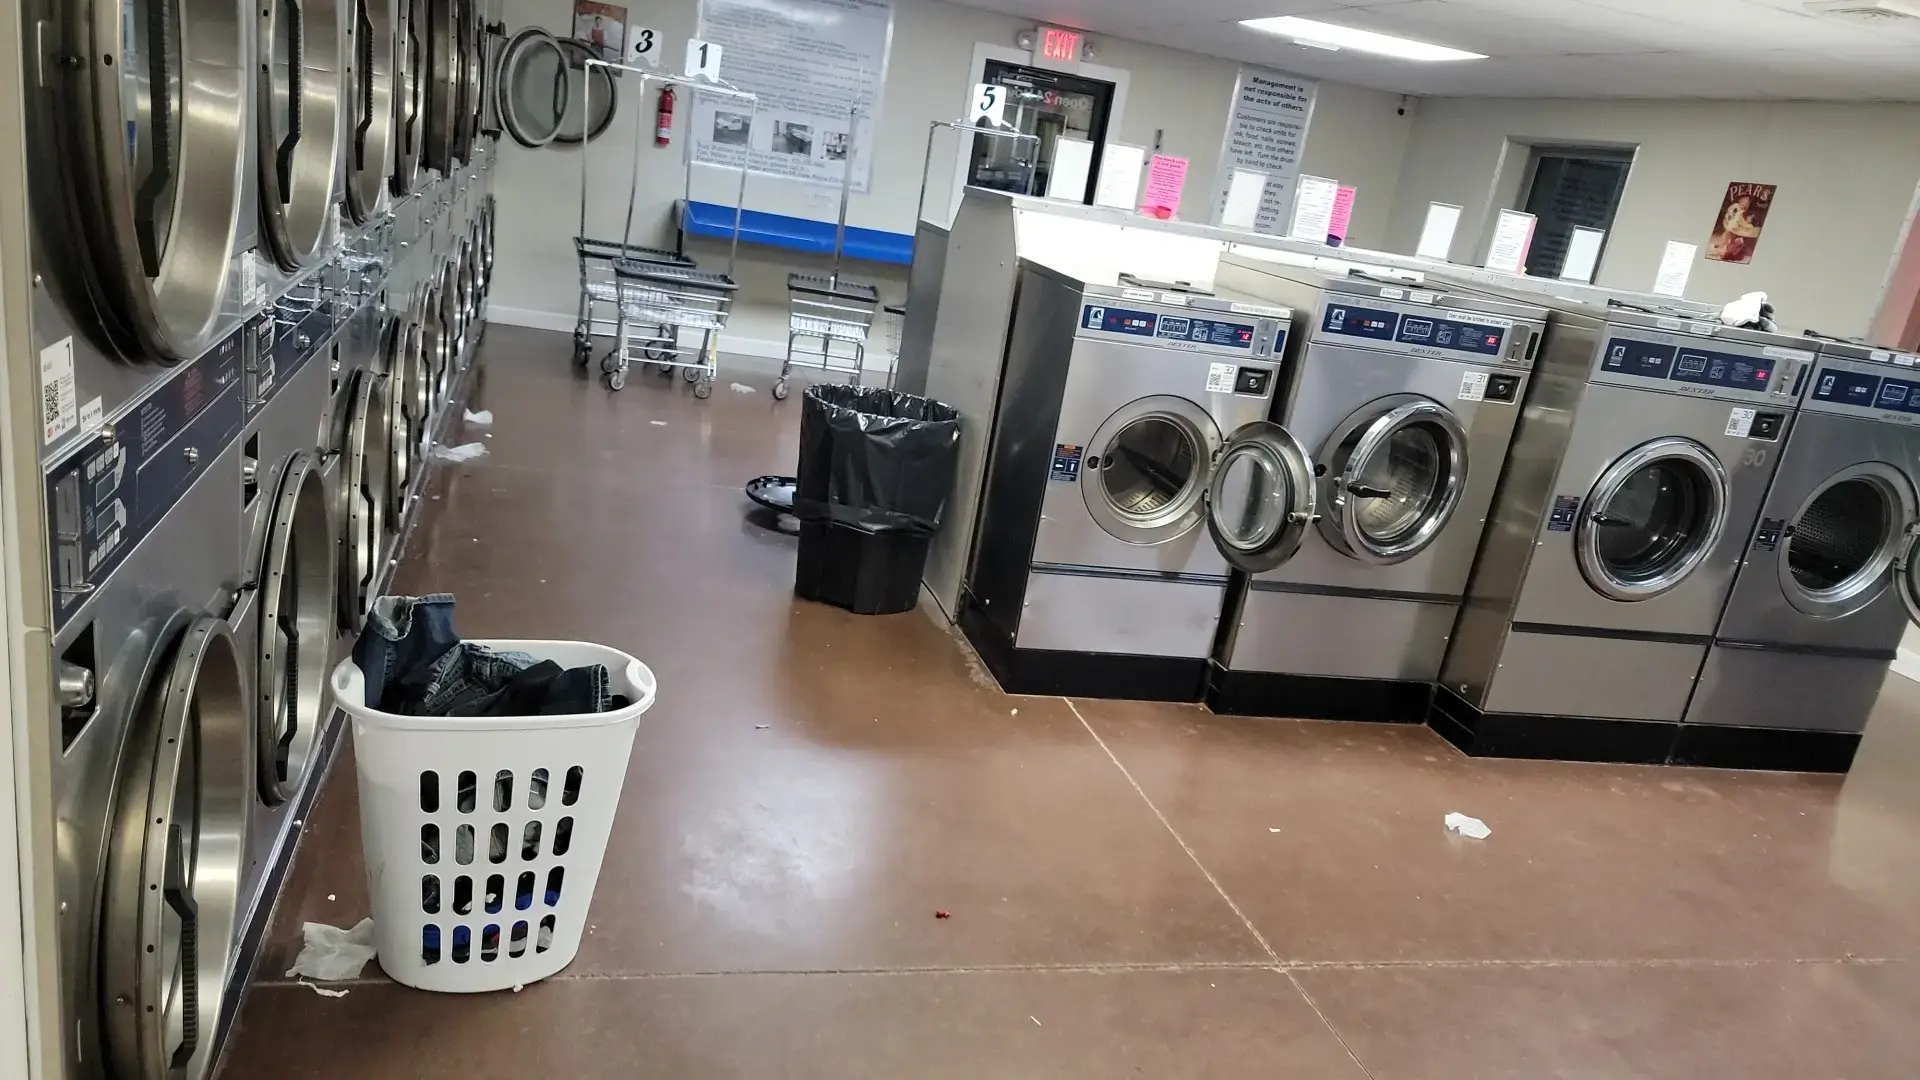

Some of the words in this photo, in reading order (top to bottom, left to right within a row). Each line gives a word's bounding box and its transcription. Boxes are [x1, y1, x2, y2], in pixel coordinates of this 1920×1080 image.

[635, 30, 654, 53] 3
[1044, 30, 1079, 60] EXIT
[699, 43, 709, 69] 1
[1252, 76, 1296, 92] Management
[980, 86, 996, 111] 5
[1243, 94, 1255, 102] the
[1257, 88, 1296, 101] responsible
[1236, 112, 1266, 123] Customers
[1277, 147, 1294, 155] others
[1730, 184, 1771, 202] PEARS
[66, 342, 72, 368] 1
[1410, 347, 1443, 356] DEXTER
[1224, 366, 1235, 375] 32
[1476, 374, 1486, 383] 31
[1680, 386, 1715, 395] DEXTER
[1741, 411, 1753, 420] 30
[1744, 449, 1767, 467] 30
